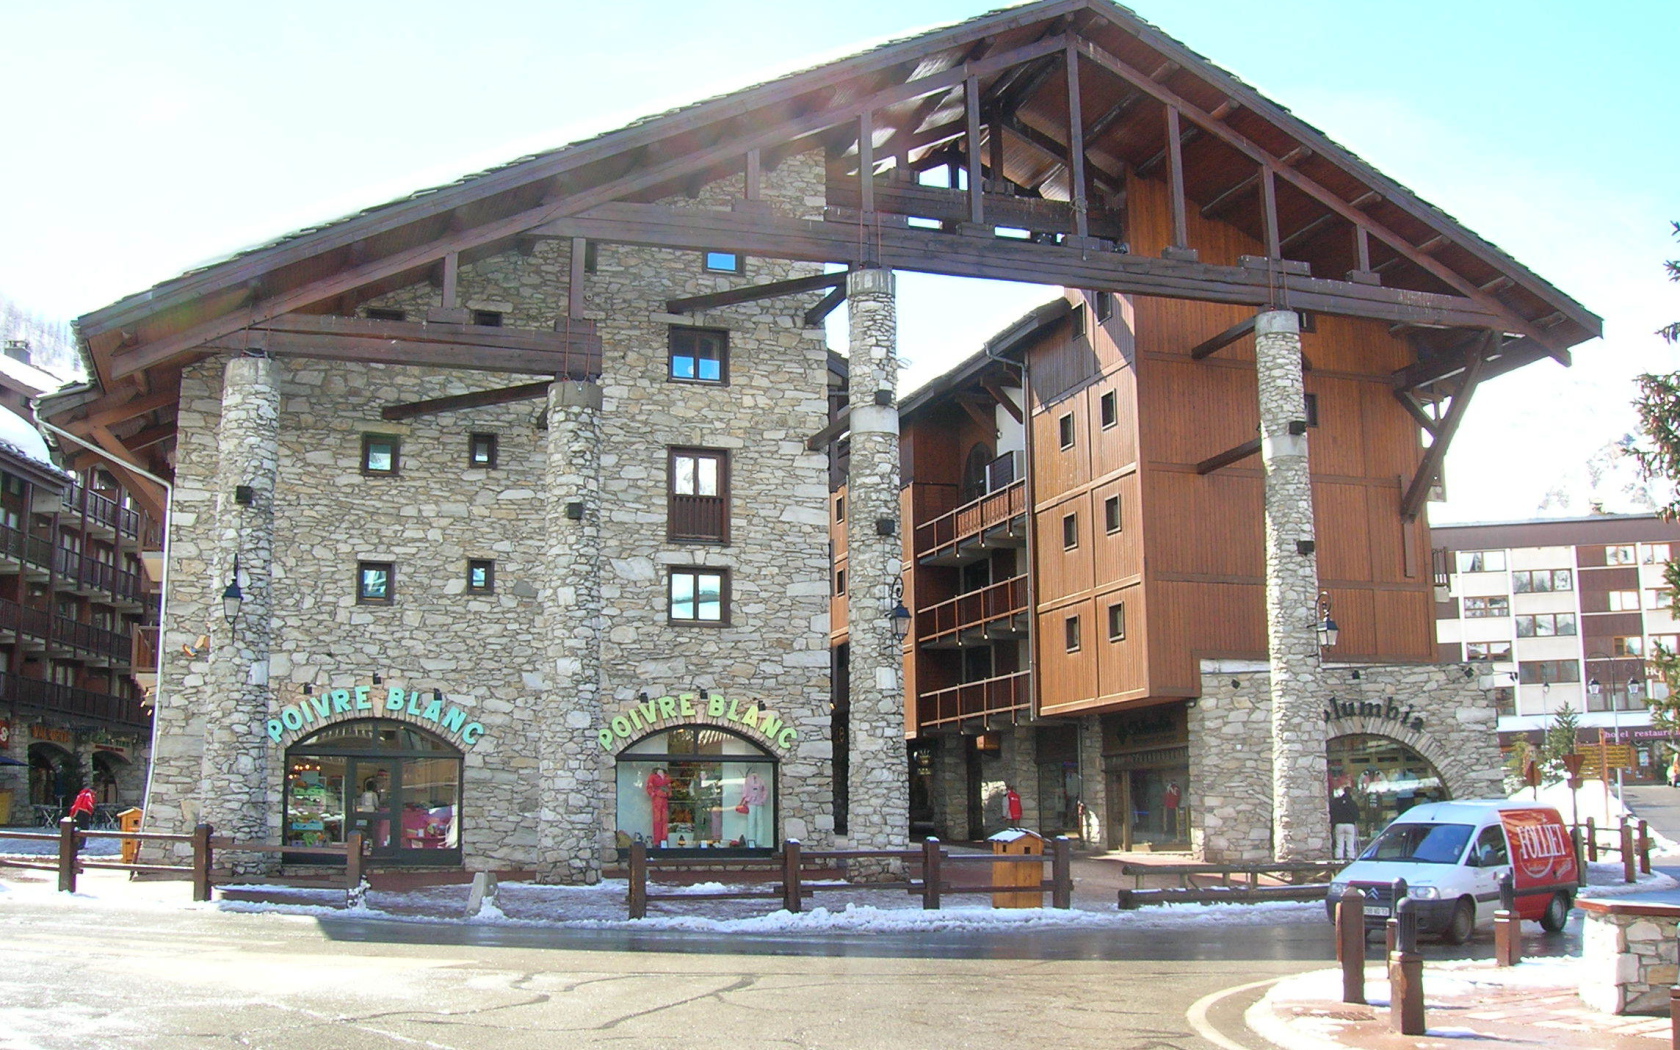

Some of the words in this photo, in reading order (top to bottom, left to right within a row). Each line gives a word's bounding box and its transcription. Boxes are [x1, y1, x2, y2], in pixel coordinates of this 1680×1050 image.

[267, 685, 373, 744] POIVRE
[386, 686, 485, 745] BLANC
[599, 693, 696, 751] POIVRE
[708, 693, 798, 749] BLANC
[1605, 730, 1629, 738] hoel
[1516, 824, 1566, 859] FOLLIET
